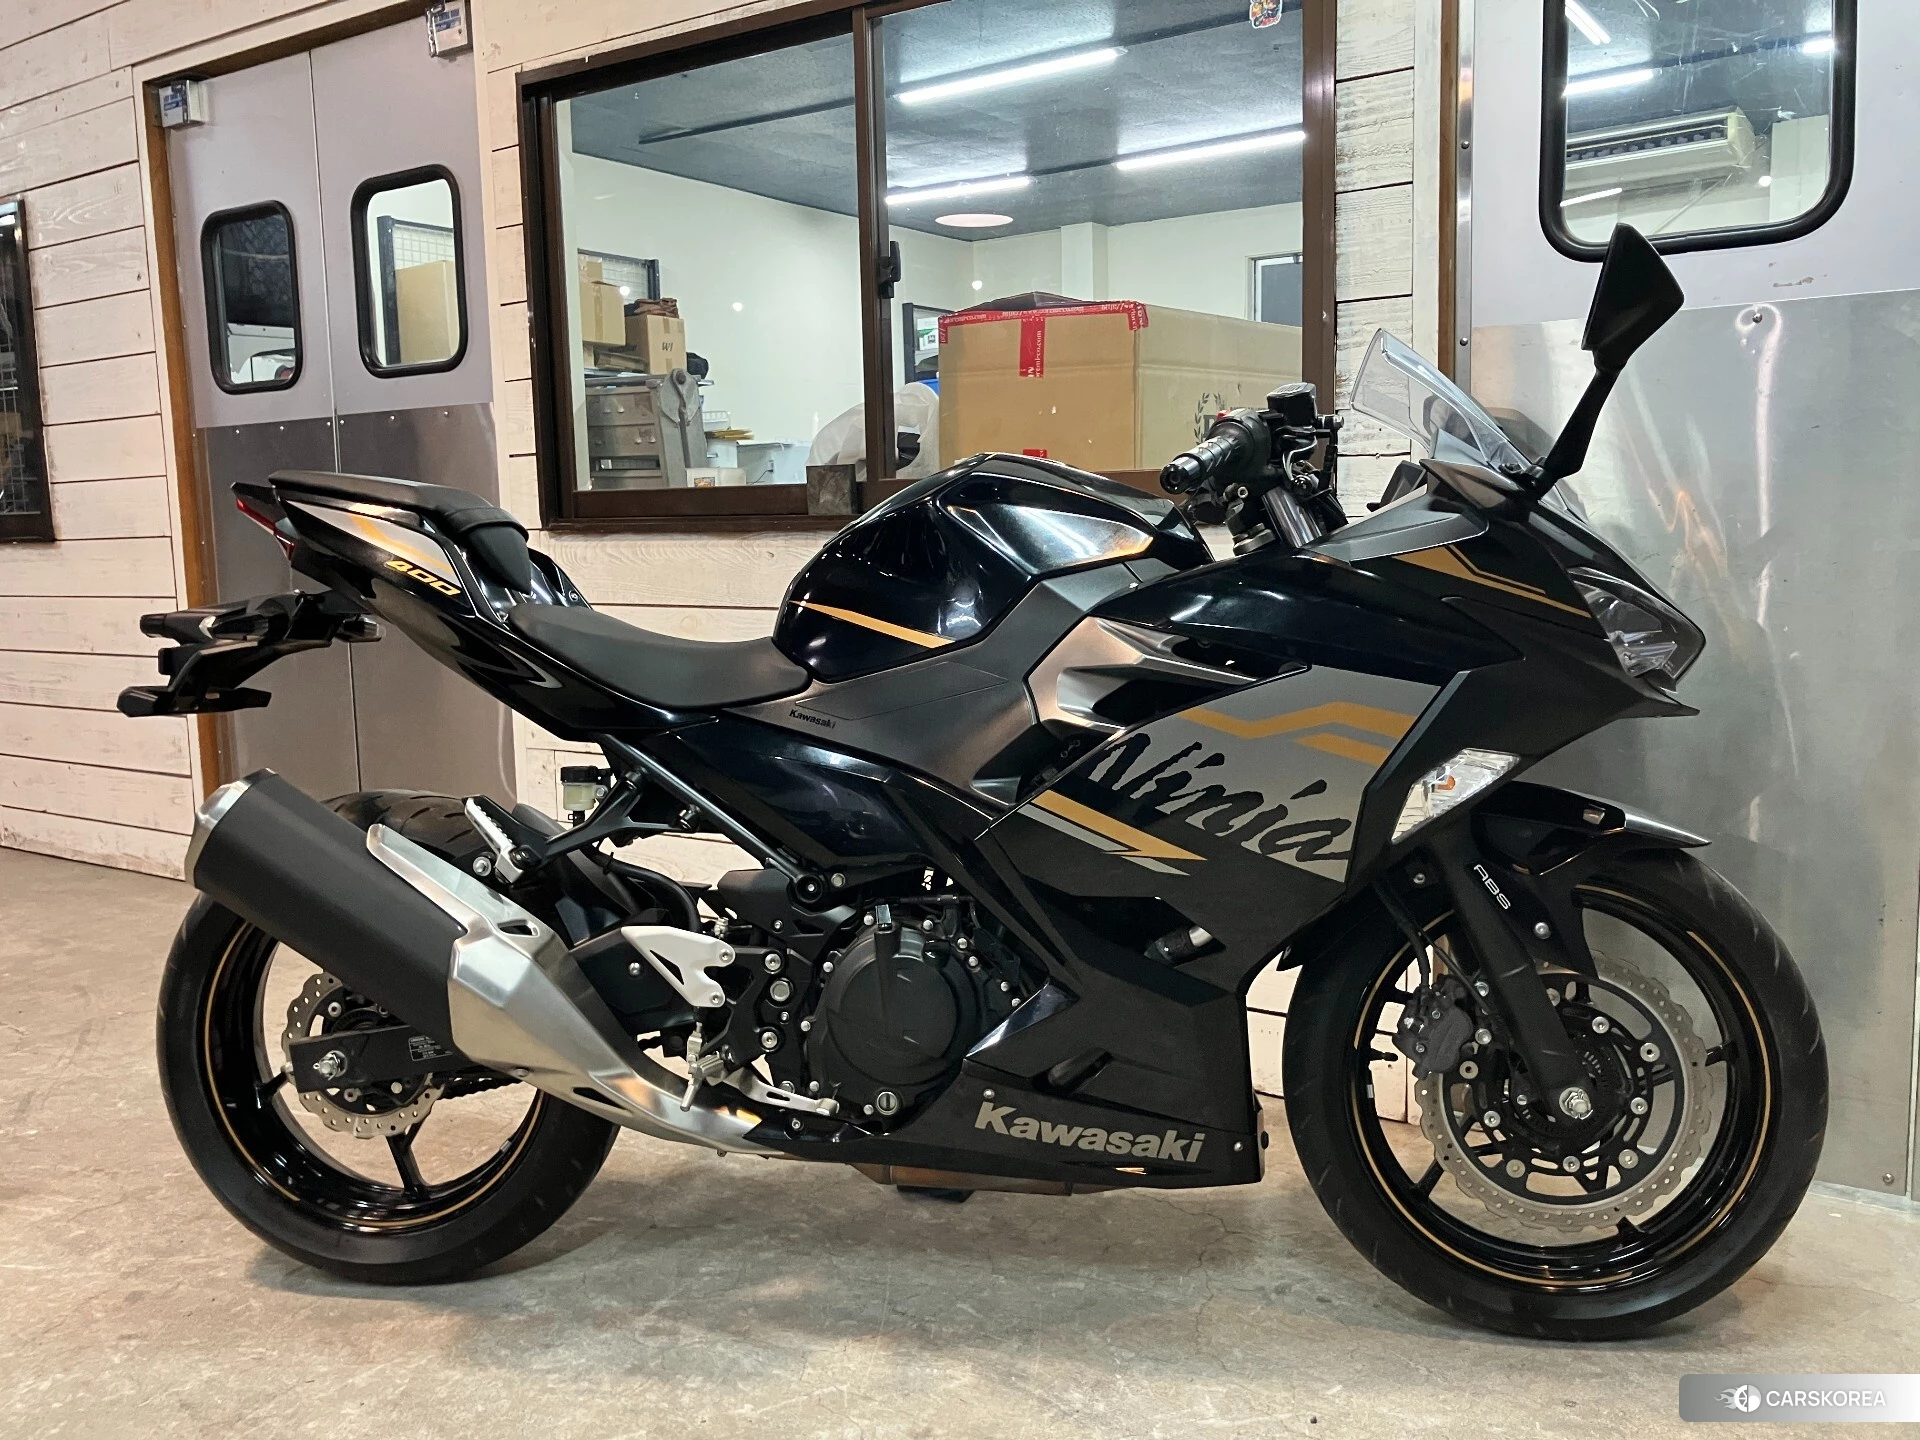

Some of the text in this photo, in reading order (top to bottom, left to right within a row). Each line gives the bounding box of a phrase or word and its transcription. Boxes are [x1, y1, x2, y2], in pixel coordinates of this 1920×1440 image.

[384, 560, 462, 596] 400
[789, 709, 837, 729] Kawasaki
[1078, 732, 1352, 863] Ninja
[1473, 864, 1511, 910] ABS
[974, 1101, 1206, 1163] Kawasaki
